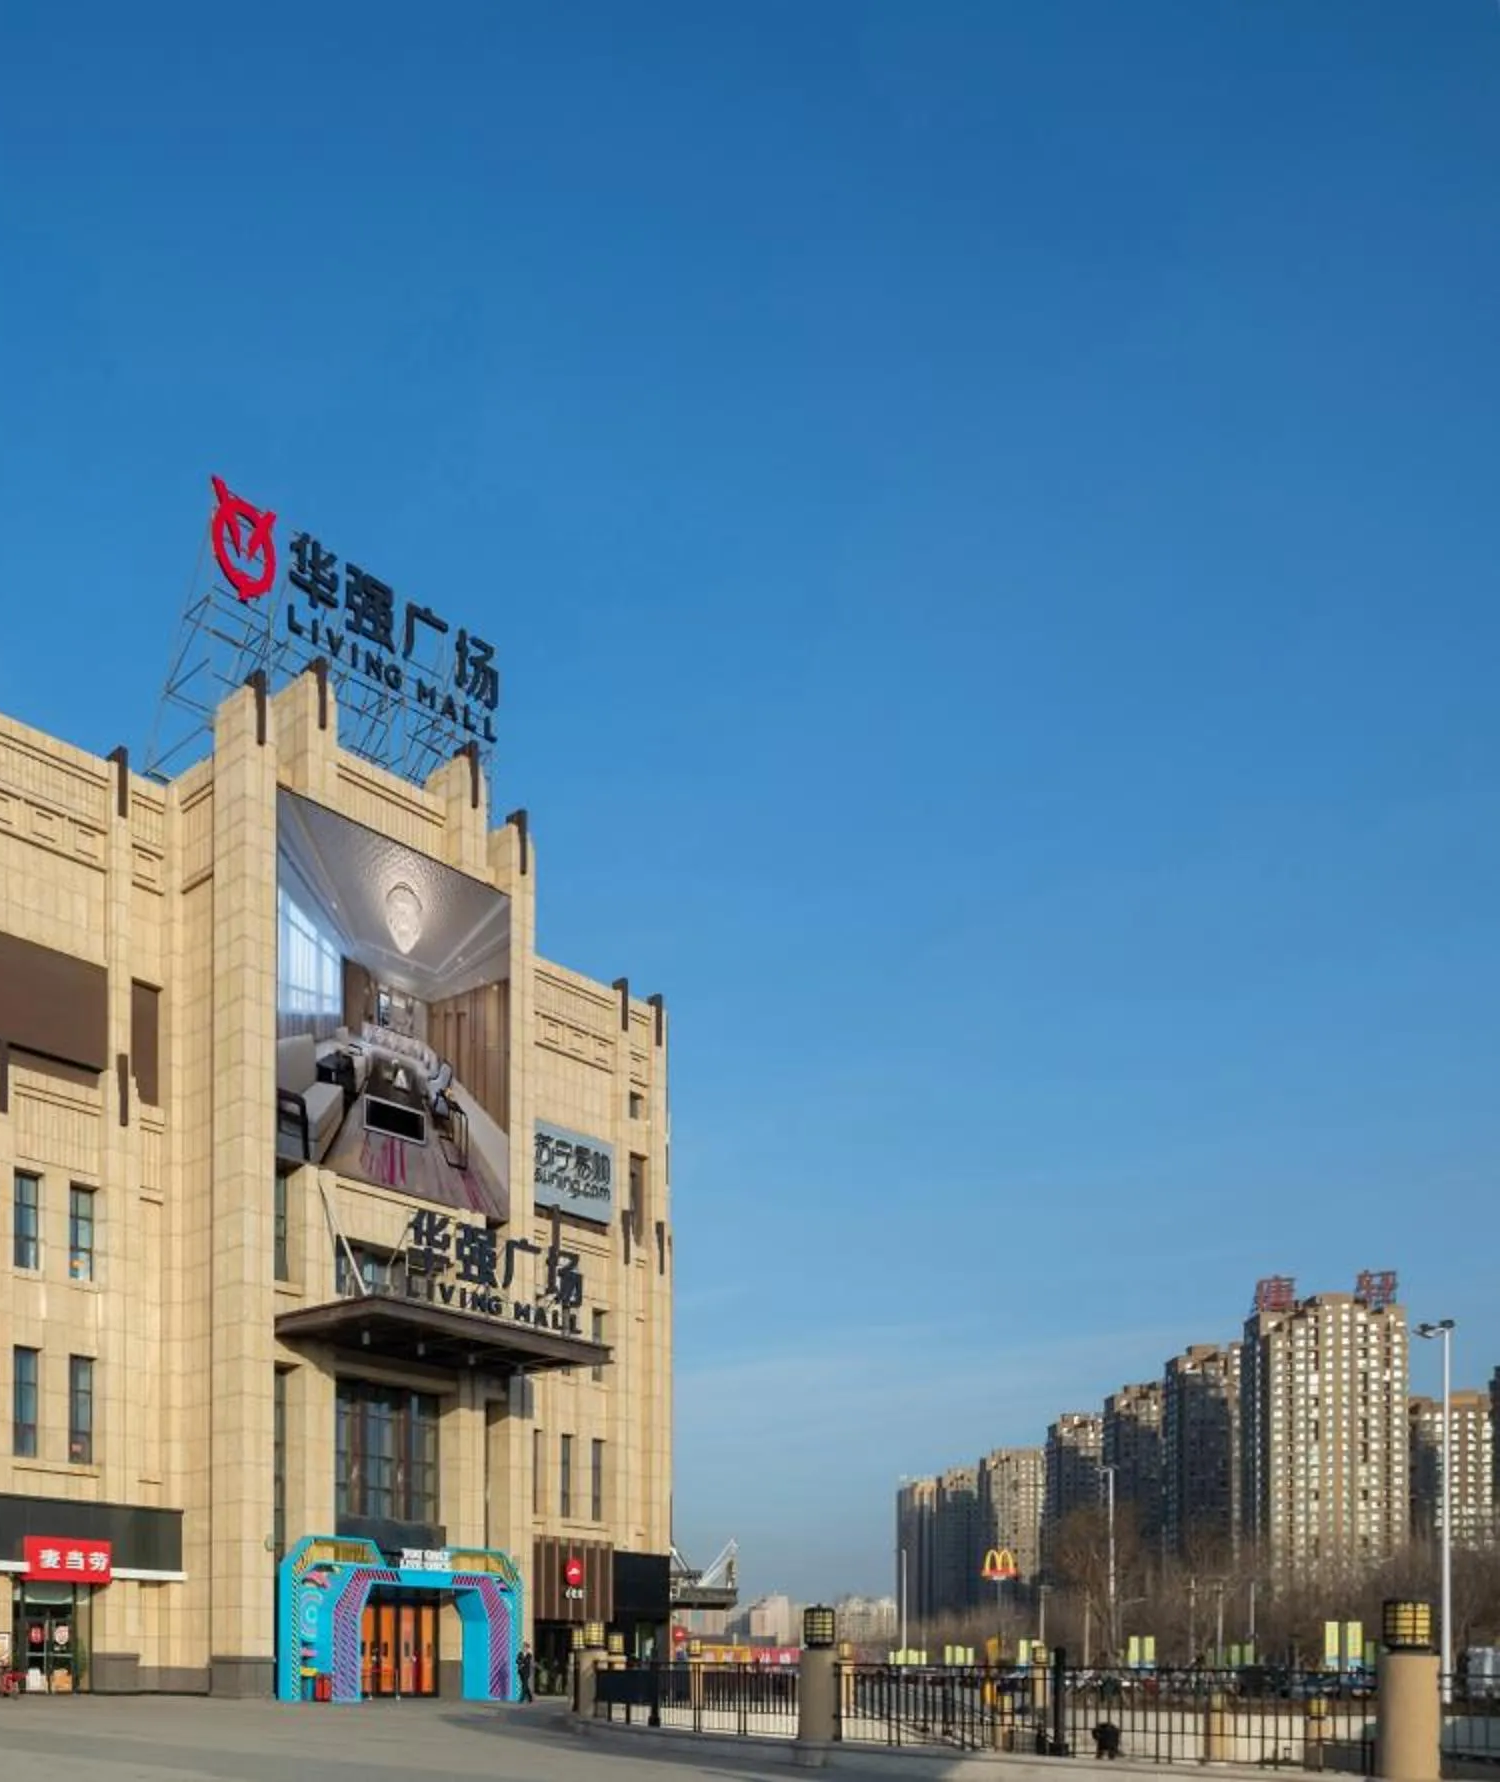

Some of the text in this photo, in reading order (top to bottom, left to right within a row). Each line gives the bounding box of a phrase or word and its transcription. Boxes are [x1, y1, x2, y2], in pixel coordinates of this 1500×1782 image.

[288, 531, 499, 711] 华强广场
[287, 602, 498, 743] LIVING MALL
[533, 1167, 611, 1201] suning.com
[406, 1208, 583, 1309] 华强广场
[513, 1301, 583, 1334] MALL
[39, 1548, 109, 1571] 麦当劳
